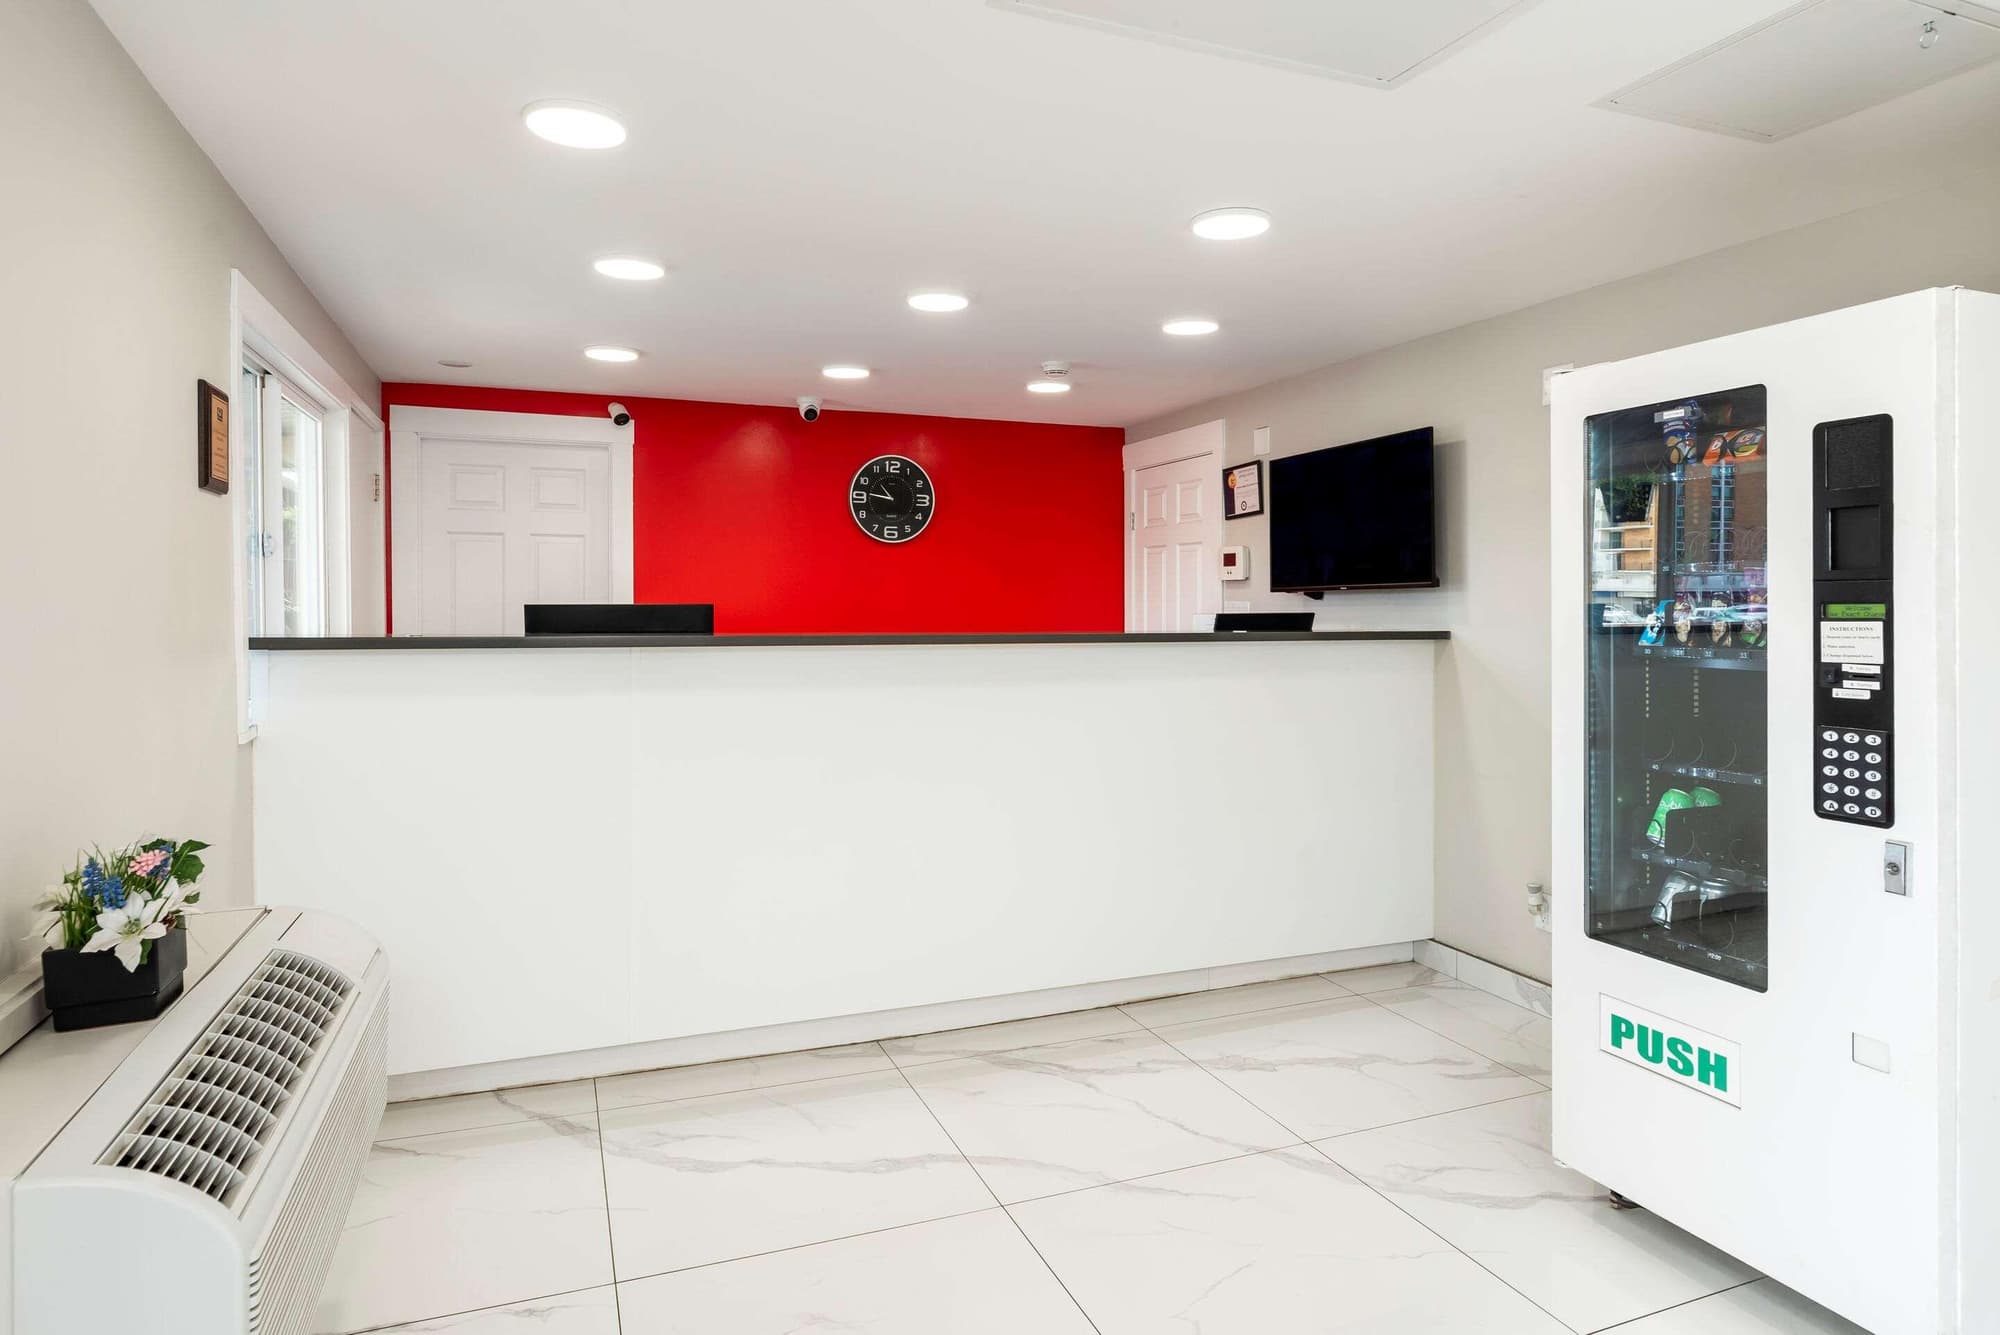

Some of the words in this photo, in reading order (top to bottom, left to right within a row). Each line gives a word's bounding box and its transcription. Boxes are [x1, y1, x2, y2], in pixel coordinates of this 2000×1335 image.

[873, 465, 880, 473] 11
[885, 461, 900, 473] 12
[906, 467, 910, 476] 1
[860, 477, 869, 485] 10
[916, 480, 923, 488] 2
[852, 491, 867, 503] 9
[915, 494, 930, 507] 3
[859, 510, 866, 519] 8
[915, 513, 922, 521] 4
[872, 524, 879, 532] 7
[904, 525, 911, 533] 5
[884, 526, 898, 539] 6
[1849, 734, 1855, 742] 2
[1610, 1013, 1728, 1093] PUSH
